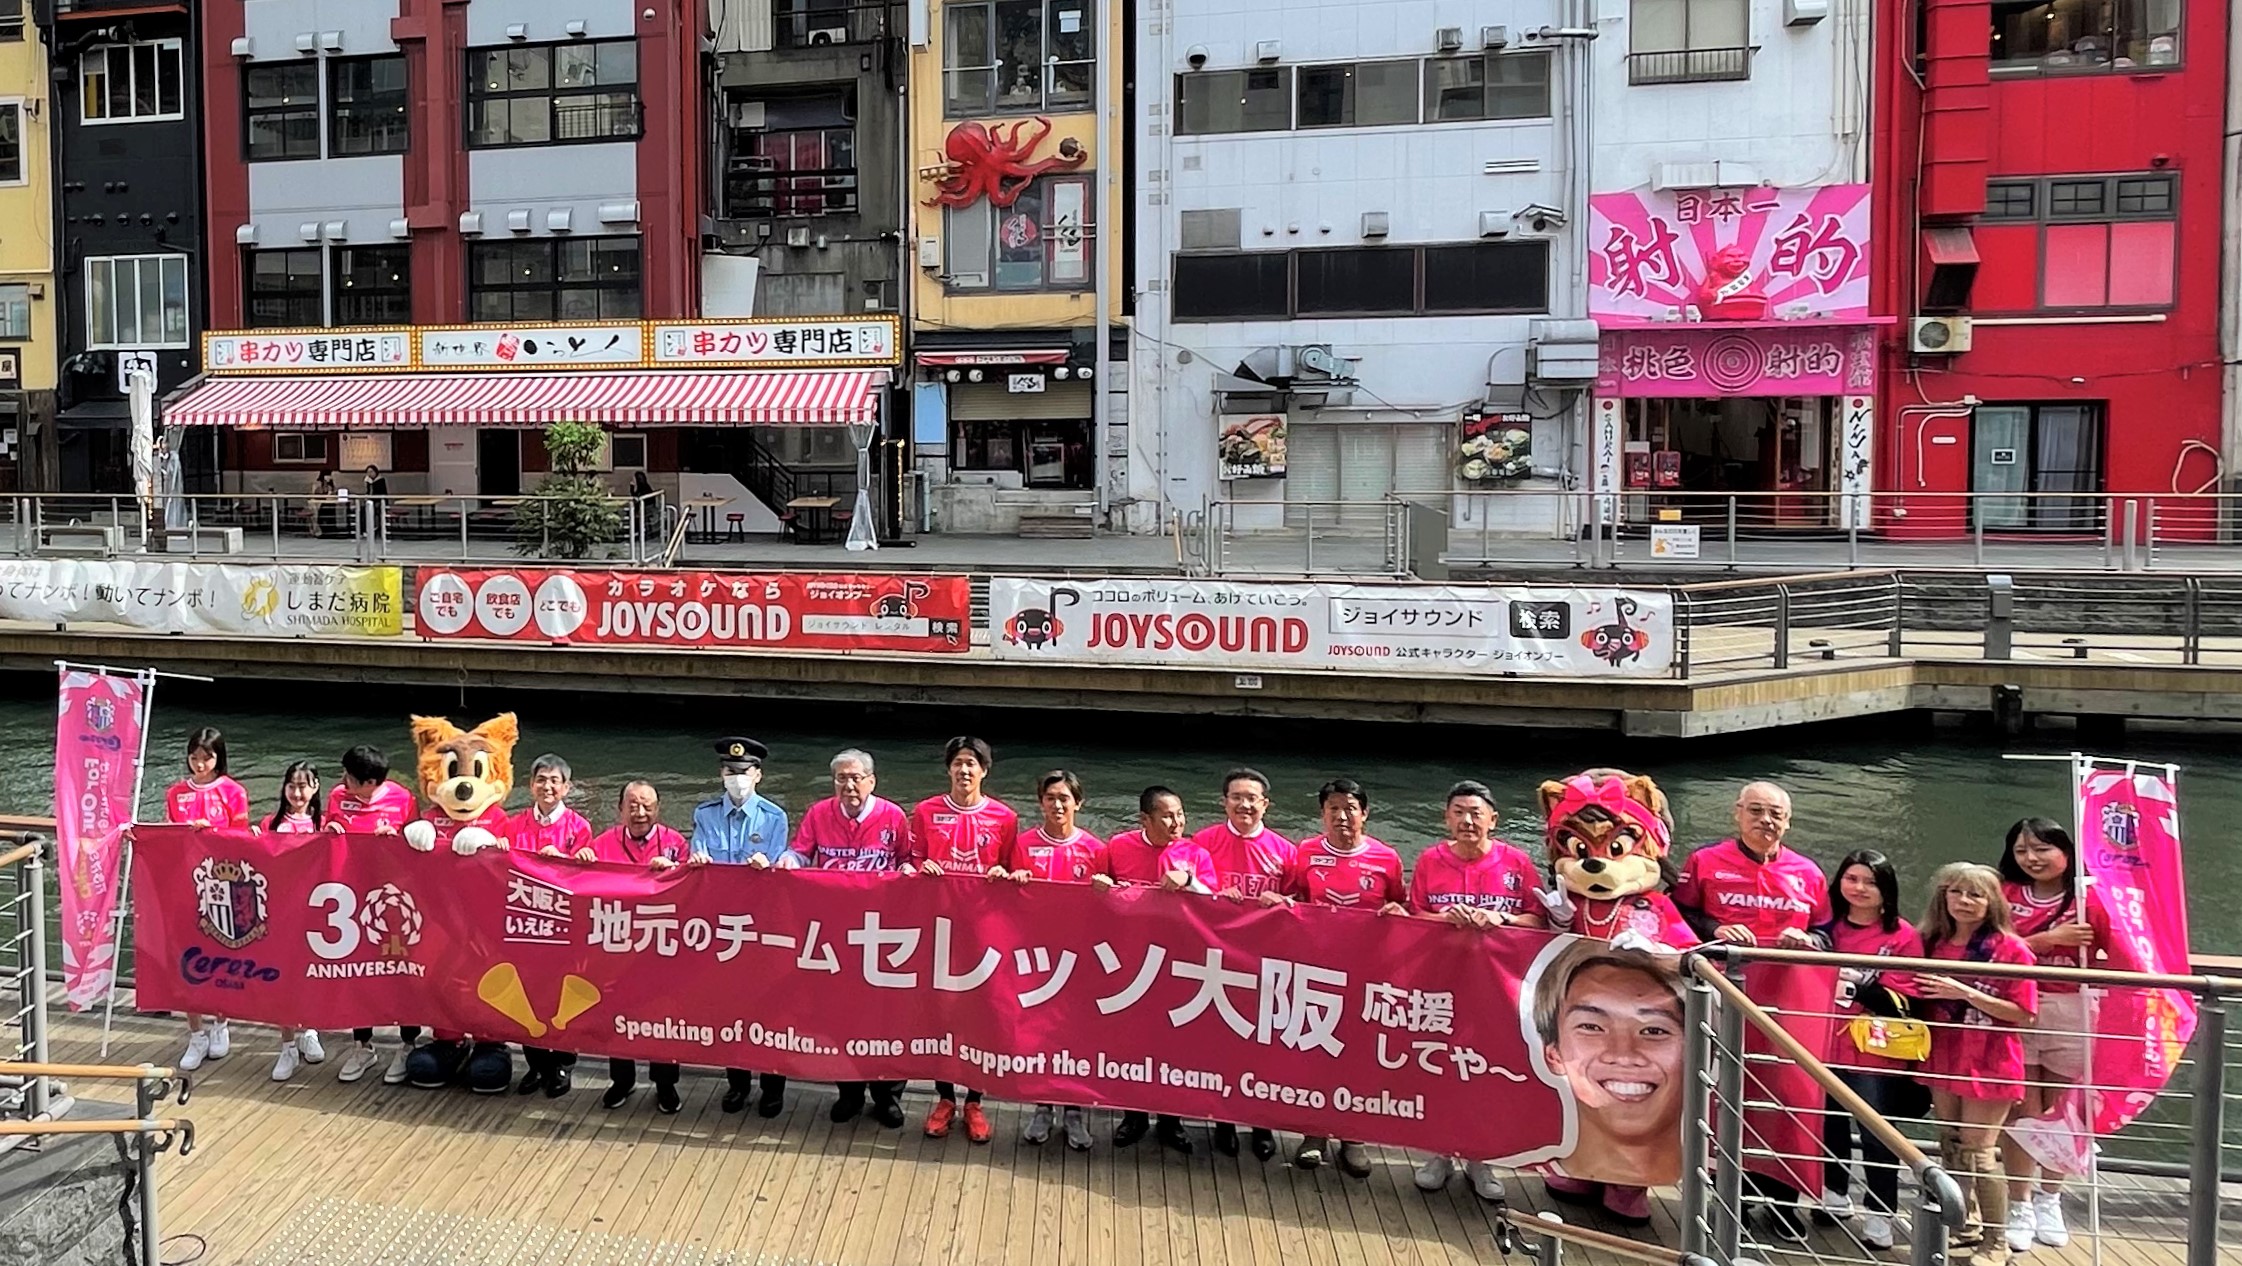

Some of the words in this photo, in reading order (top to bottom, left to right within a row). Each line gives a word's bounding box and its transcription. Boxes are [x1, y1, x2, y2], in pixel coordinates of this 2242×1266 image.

[1677, 192, 1782, 224] 日本一
[240, 339, 376, 364] 串カツ専門店
[693, 328, 853, 357] 串カツ専門店
[1622, 345, 1697, 380] 桃色
[1765, 343, 1844, 379] 射的
[429, 591, 464, 604] ご自宅
[486, 593, 521, 605] 飲食店
[608, 579, 781, 600] カラオケなら
[1093, 590, 1308, 607] ココロのボリューム、あげていこう。
[288, 591, 391, 614] しまだ病院
[436, 605, 458, 617] でも
[493, 607, 515, 619] でも
[540, 601, 581, 612] どこでも
[287, 614, 338, 626] SHIMADA
[340, 616, 391, 628] HOSPITAL
[597, 601, 791, 640] JOYSOUND
[1343, 607, 1484, 629] ジョイサウンド
[1519, 609, 1562, 630] 検索
[1087, 612, 1308, 653] JOYSOUND
[1328, 645, 1391, 657] JOYSOUND
[1396, 647, 1487, 660] 公式キャラクター
[507, 877, 571, 916] 大阪と
[181, 946, 280, 985] Cerezo
[306, 960, 426, 978] ANNIVERSARY
[1362, 981, 1455, 1036] 応援
[614, 1015, 714, 1046] Speaking
[720, 1020, 744, 1043] of
[748, 1025, 839, 1056] Osaka...
[845, 1036, 904, 1057] come
[910, 1033, 953, 1057] and
[959, 1044, 1047, 1079] support
[1052, 1050, 1090, 1078] the
[1098, 1052, 1153, 1083] local
[1159, 1063, 1232, 1098] team,
[1239, 1072, 1326, 1109] Cerezo
[1333, 1086, 1426, 1120] Osaka!
